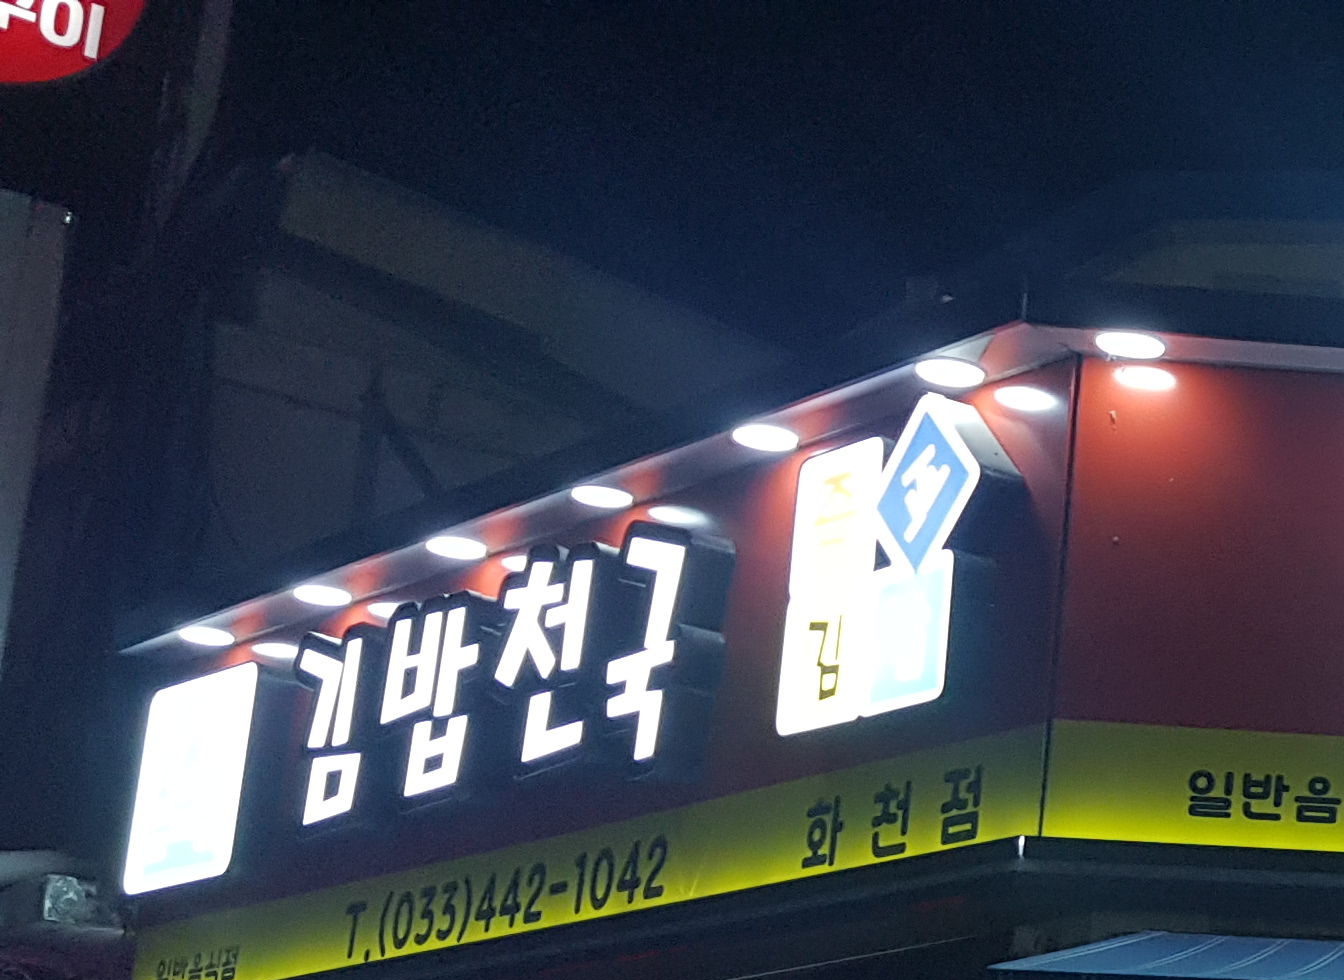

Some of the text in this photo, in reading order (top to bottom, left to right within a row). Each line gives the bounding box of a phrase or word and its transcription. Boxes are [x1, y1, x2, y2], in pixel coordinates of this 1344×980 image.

[298, 533, 692, 826] 김밥천국
[801, 765, 984, 870] 화천점
[344, 835, 670, 963] T.(033)442-1042
